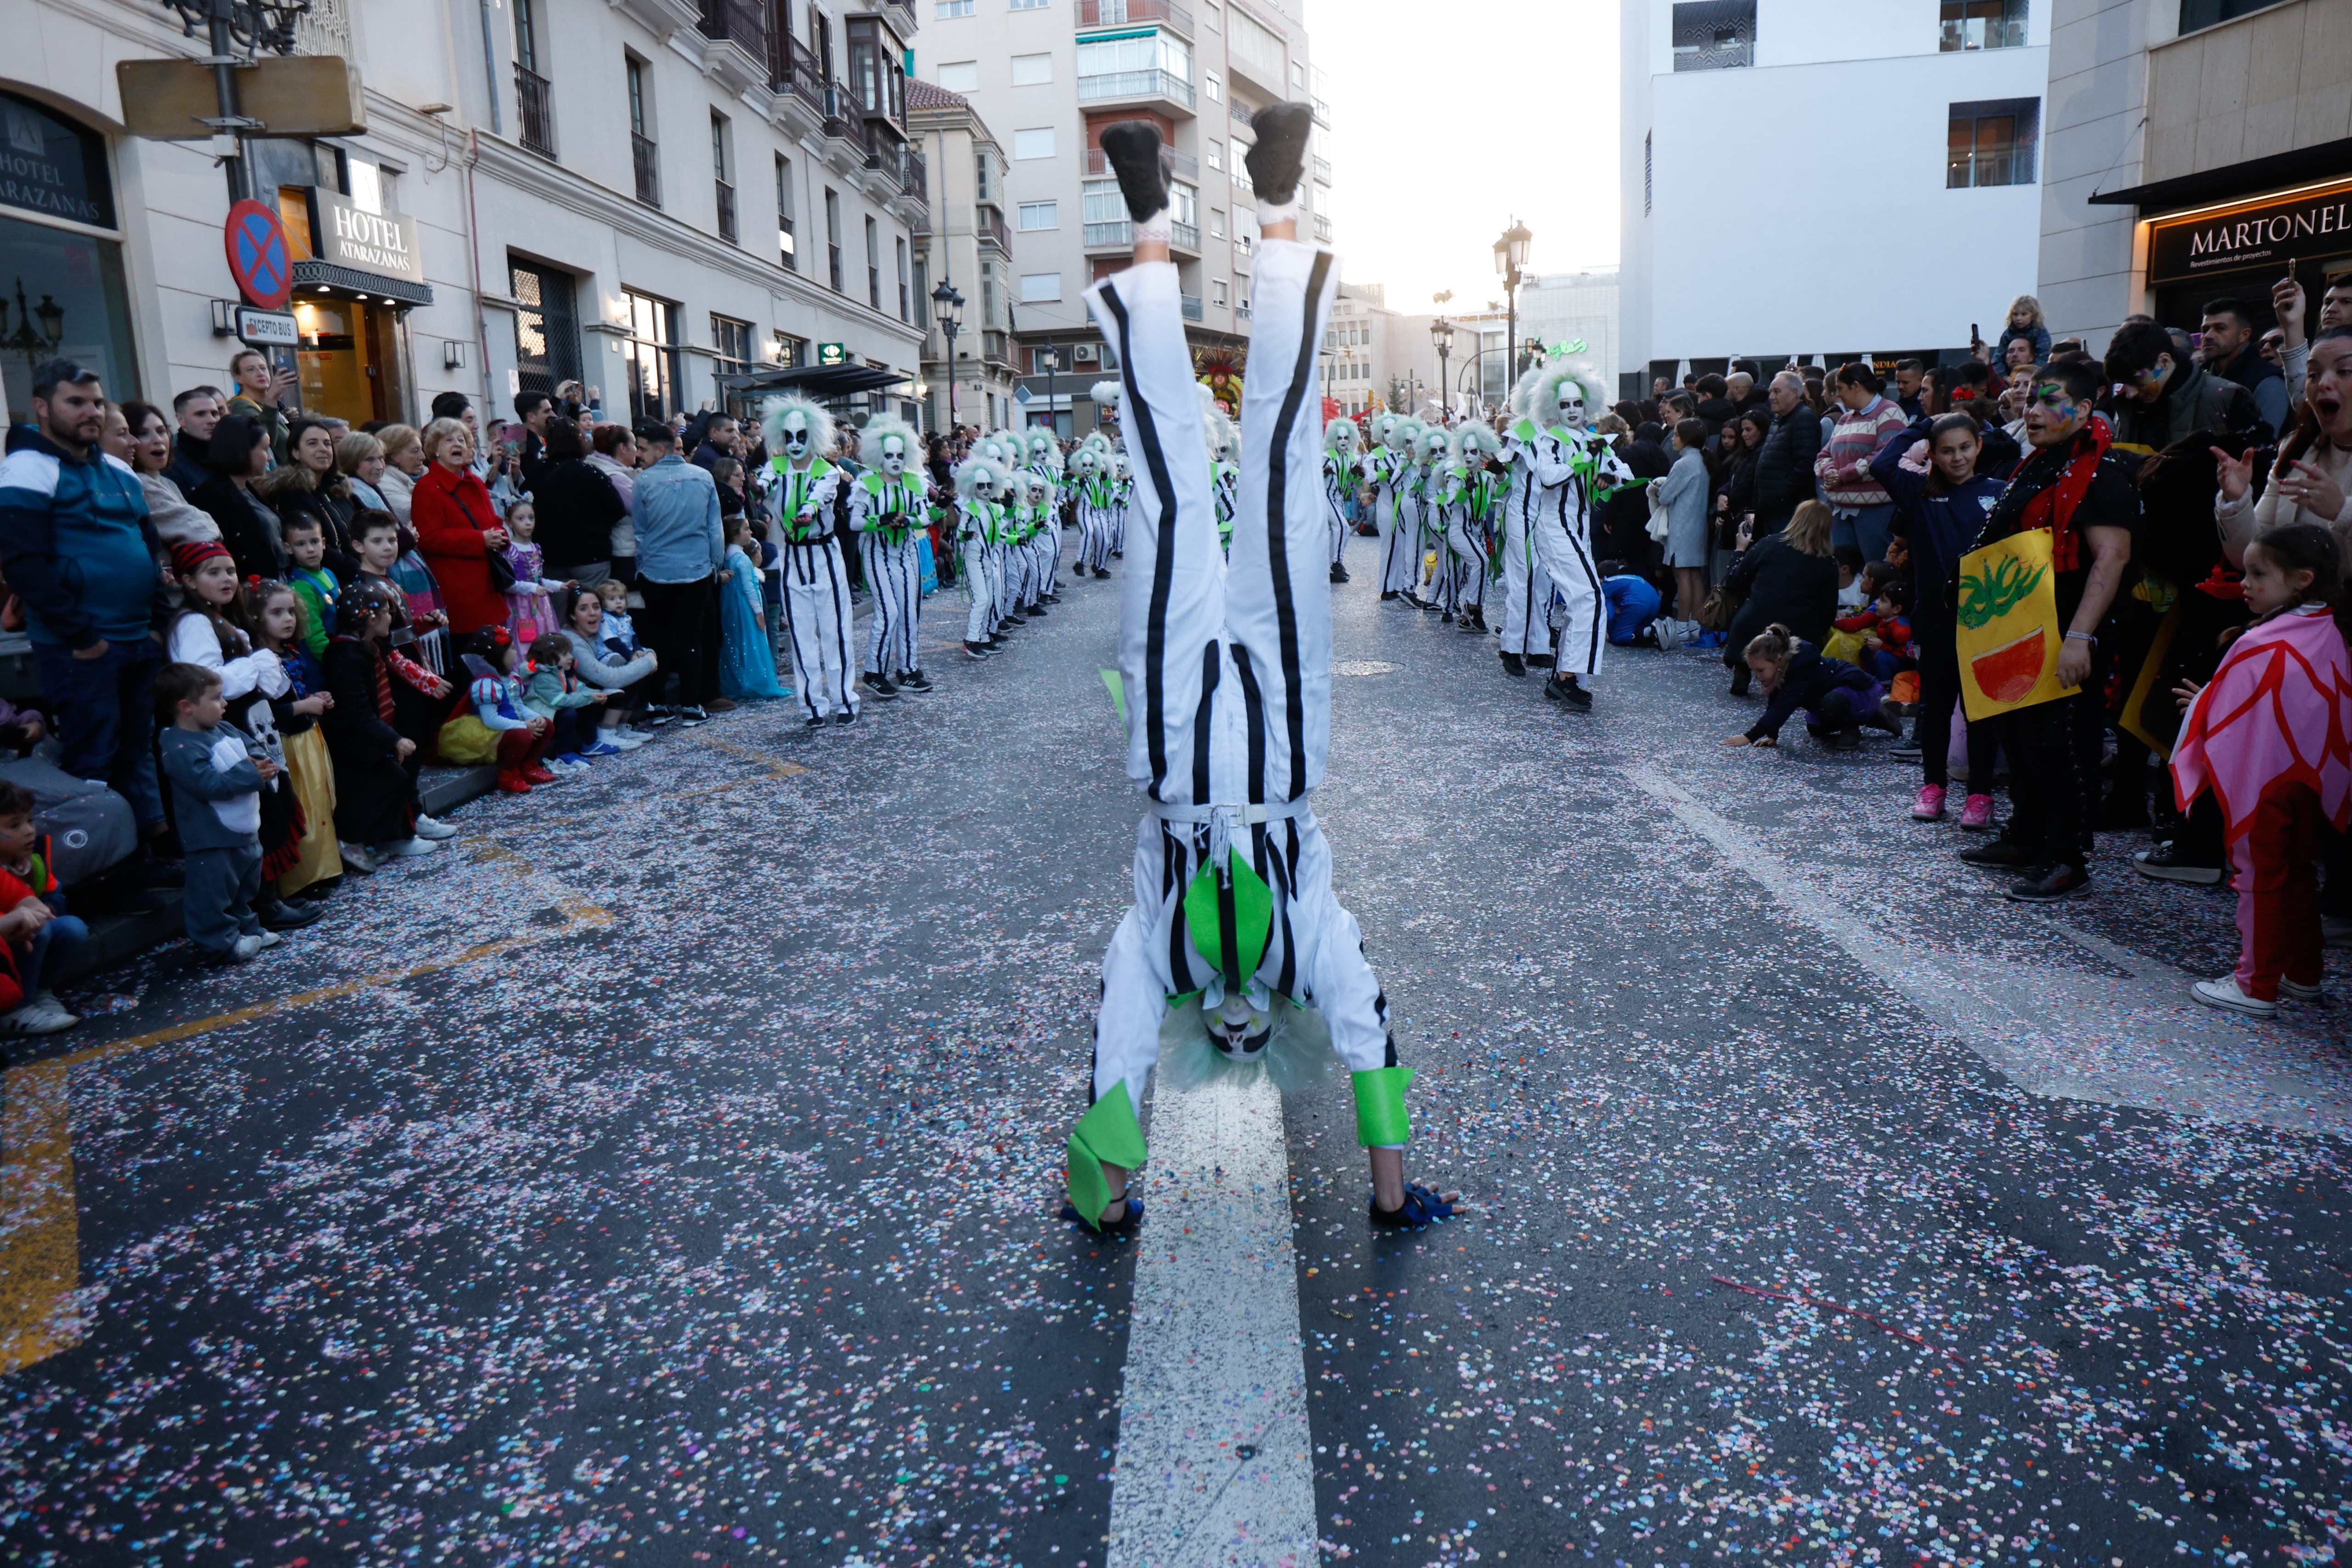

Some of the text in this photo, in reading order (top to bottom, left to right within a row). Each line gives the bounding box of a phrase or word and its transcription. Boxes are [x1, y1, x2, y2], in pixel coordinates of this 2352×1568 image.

[0, 152, 64, 186] HOTEL
[333, 204, 408, 254] HOTEL
[2190, 203, 2352, 256] MARTONEL
[339, 240, 410, 272] ATARAZANAS
[2190, 249, 2272, 269] Revestimientos de proyectos
[278, 322, 292, 337] BUS
[1533, 334, 1588, 362] nglés
